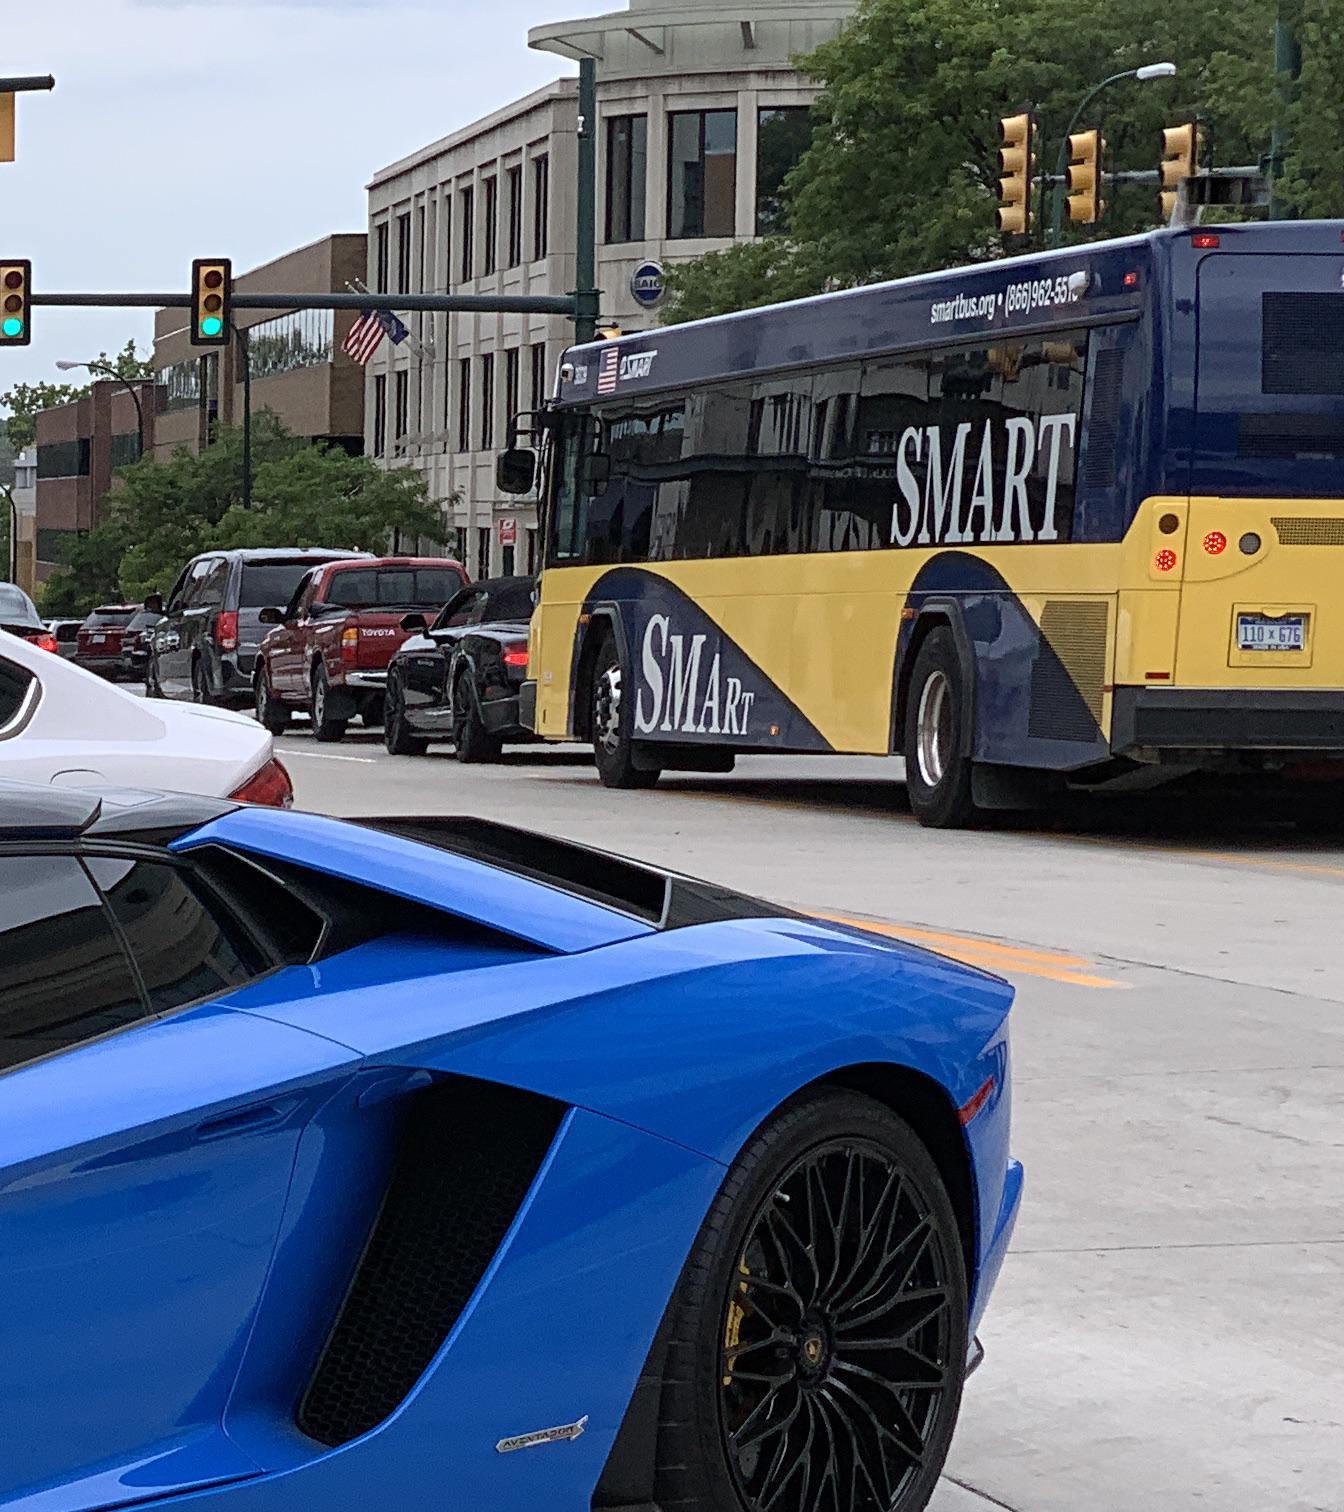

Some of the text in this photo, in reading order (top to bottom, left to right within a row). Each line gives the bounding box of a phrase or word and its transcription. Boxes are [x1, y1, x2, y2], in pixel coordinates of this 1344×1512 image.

[931, 275, 1078, 325] smartbus.org (866)962-55
[890, 413, 1076, 547] SMART
[1243, 626, 1264, 642] 110
